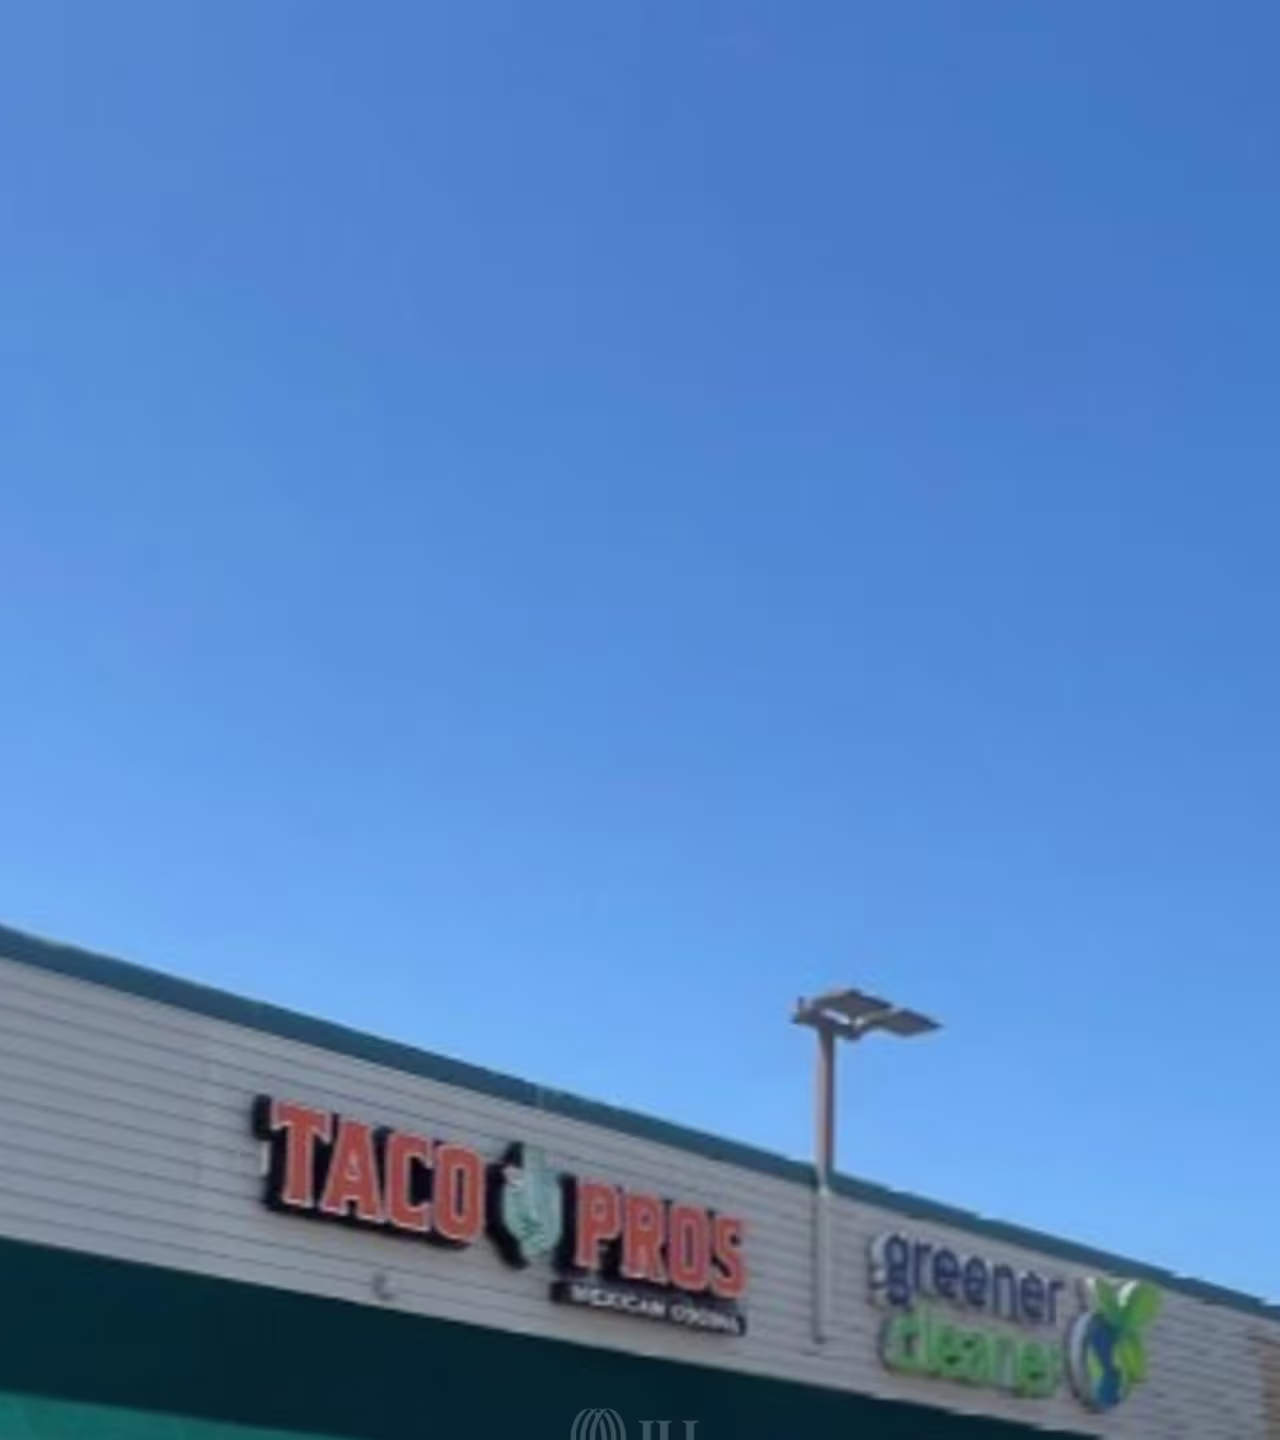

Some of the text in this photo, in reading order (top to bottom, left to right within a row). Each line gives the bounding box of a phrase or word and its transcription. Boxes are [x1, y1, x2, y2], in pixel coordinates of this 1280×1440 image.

[269, 1098, 750, 1300] TACO PROS
[880, 1231, 1066, 1326] greener
[886, 1303, 1062, 1400] cleaner
